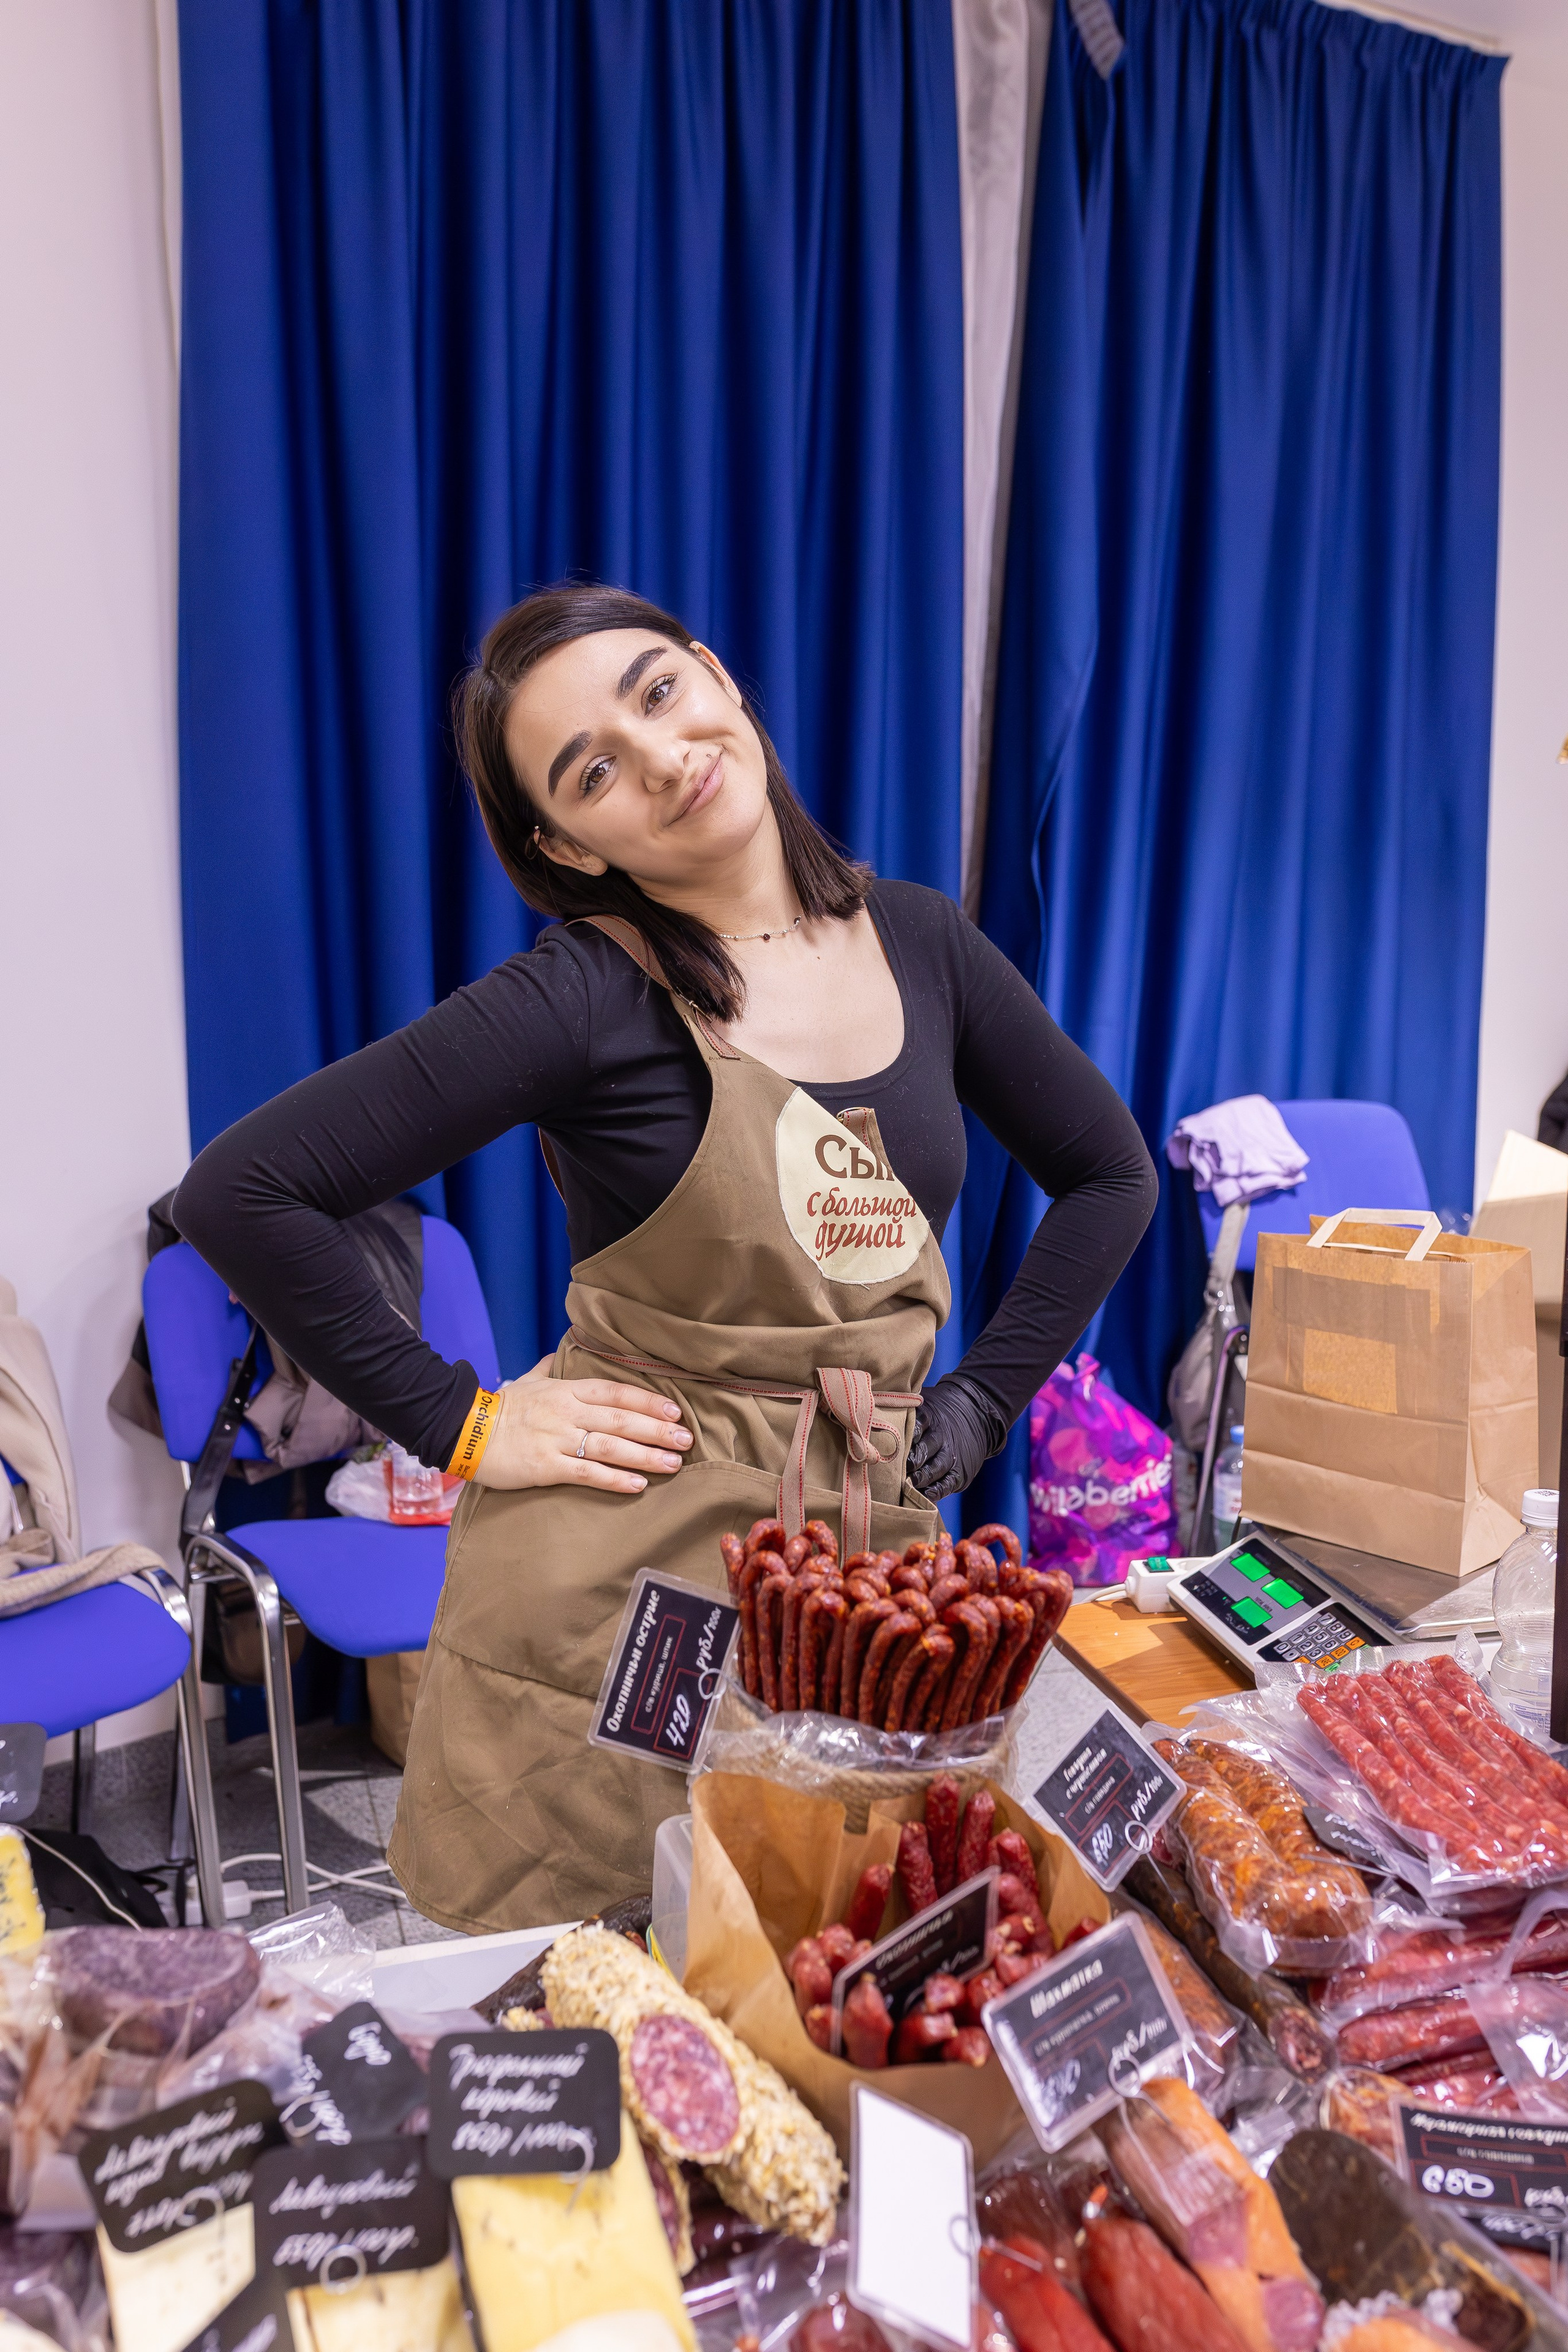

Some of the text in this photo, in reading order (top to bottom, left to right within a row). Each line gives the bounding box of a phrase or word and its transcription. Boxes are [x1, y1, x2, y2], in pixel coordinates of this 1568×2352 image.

[815, 1216, 906, 1261] душой
[463, 1396, 492, 1460] Orchidium
[1300, 1642, 1312, 1650] 2
[1324, 1640, 1336, 1649] 6
[1330, 1623, 1341, 1631] 8
[1340, 1631, 1351, 1640] 9
[606, 1647, 643, 1733] Охотничьи
[665, 1694, 691, 1746] 420
